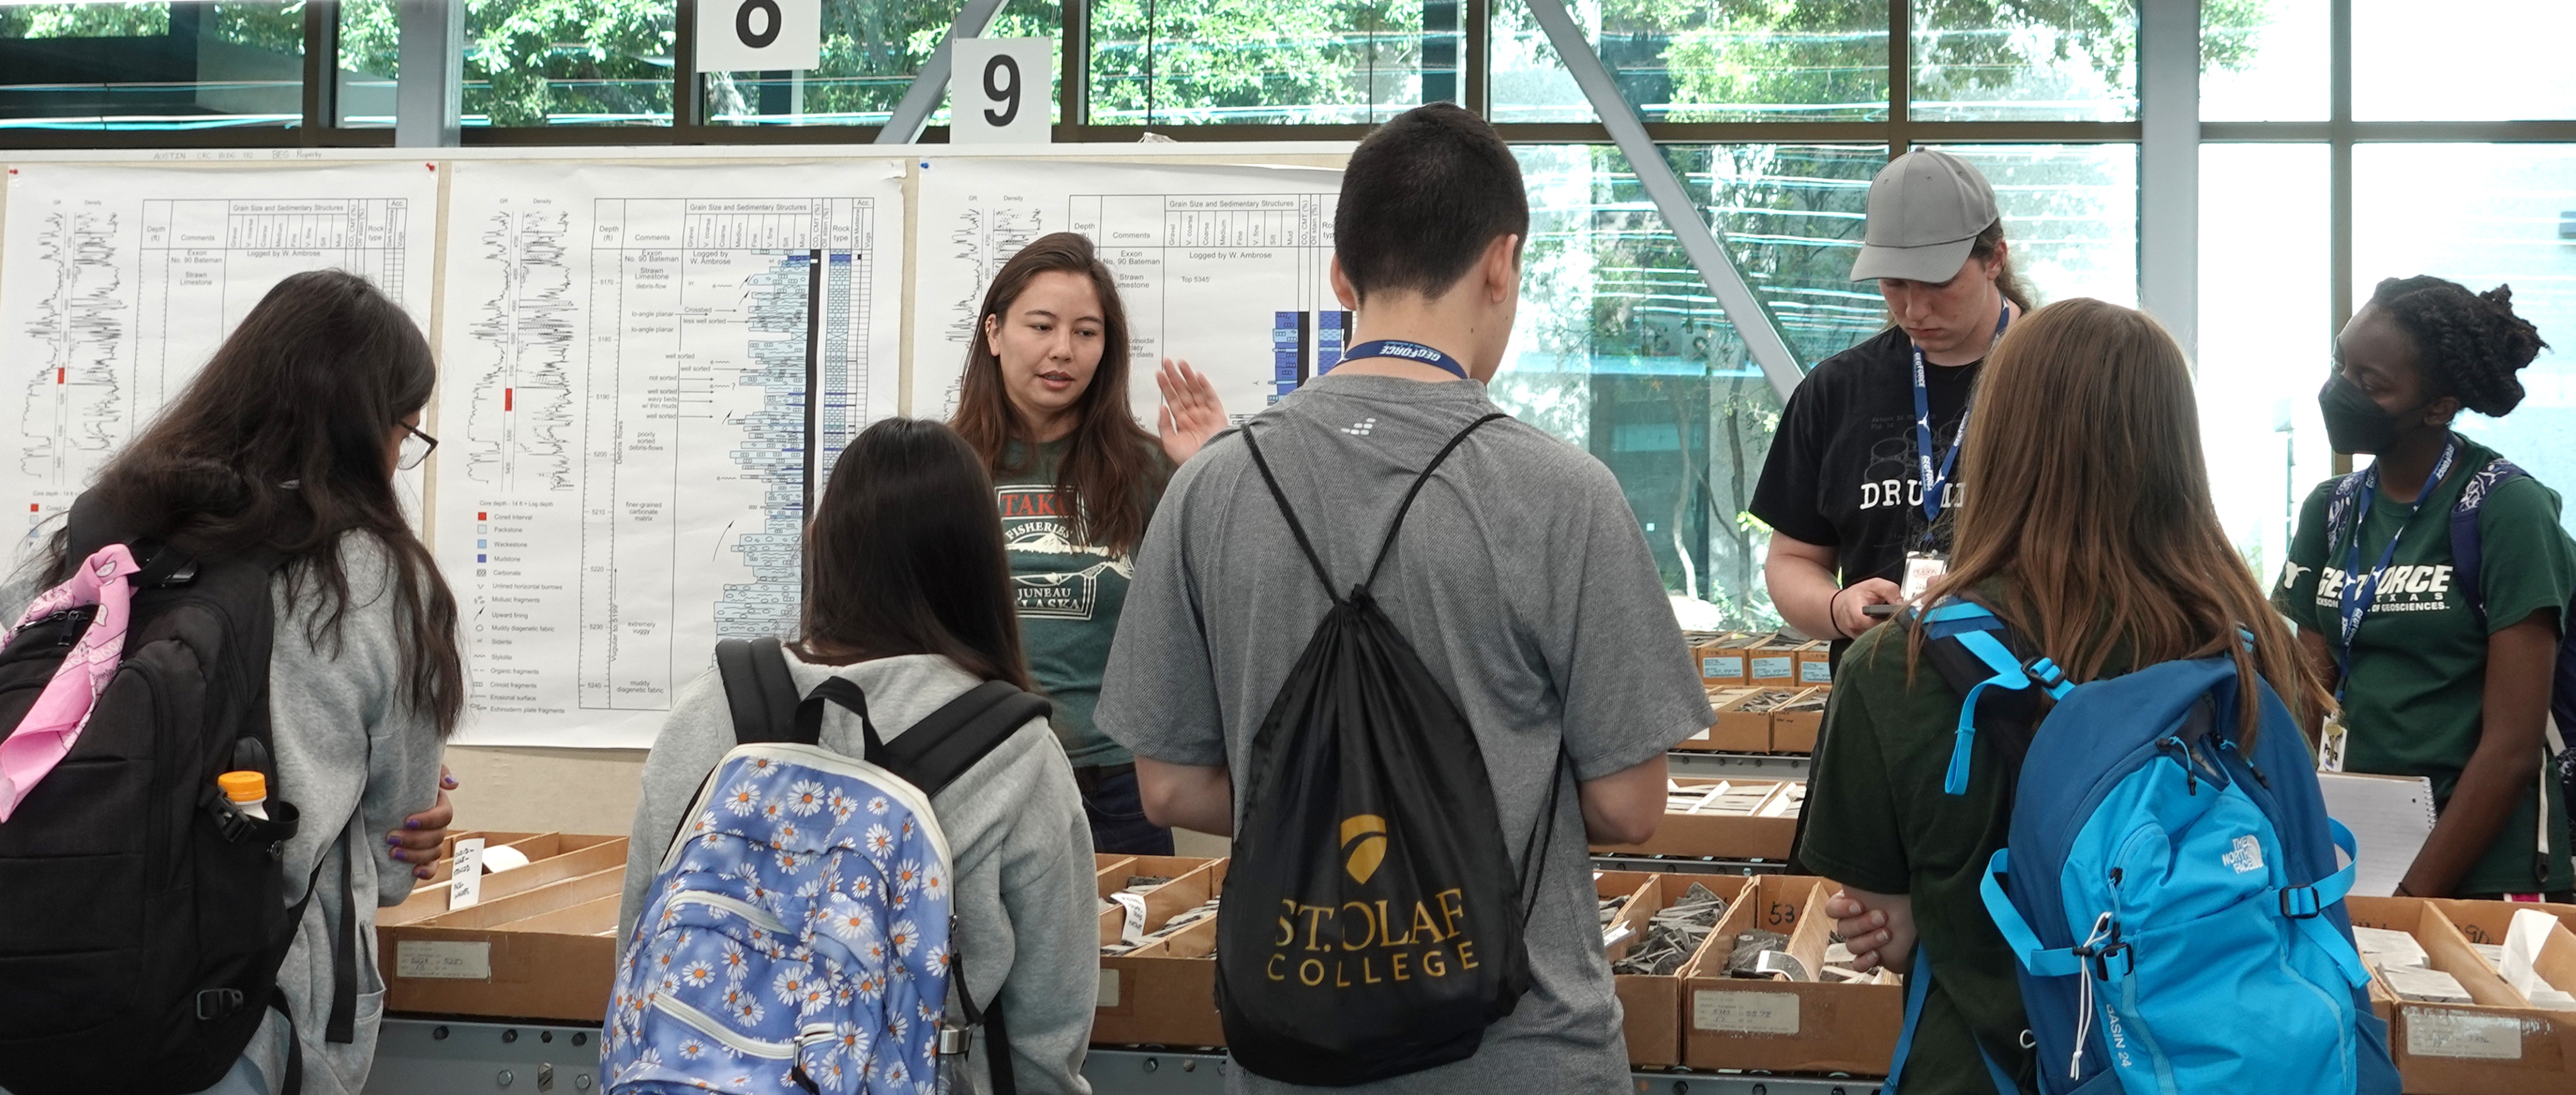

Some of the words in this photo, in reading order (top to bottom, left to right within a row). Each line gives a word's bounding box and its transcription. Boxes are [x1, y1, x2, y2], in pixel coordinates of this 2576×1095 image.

[984, 54, 1021, 127] 9
[297, 150, 322, 158] Property
[1006, 521, 1070, 540] FISHERIES
[1018, 588, 1071, 600] JUNEAU
[2376, 592, 2444, 603] EXAS
[1020, 599, 1080, 609] LASKA
[2372, 604, 2380, 613] OF
[2232, 836, 2248, 851] THE
[2222, 848, 2251, 867] NORTH
[2233, 859, 2253, 874] FACE
[1275, 898, 1336, 954] ST.
[1341, 887, 1466, 952] OLAF
[1768, 901, 1794, 925] 53
[1267, 940, 1480, 989] COLLEGE
[2118, 1052, 2132, 1068] 24
